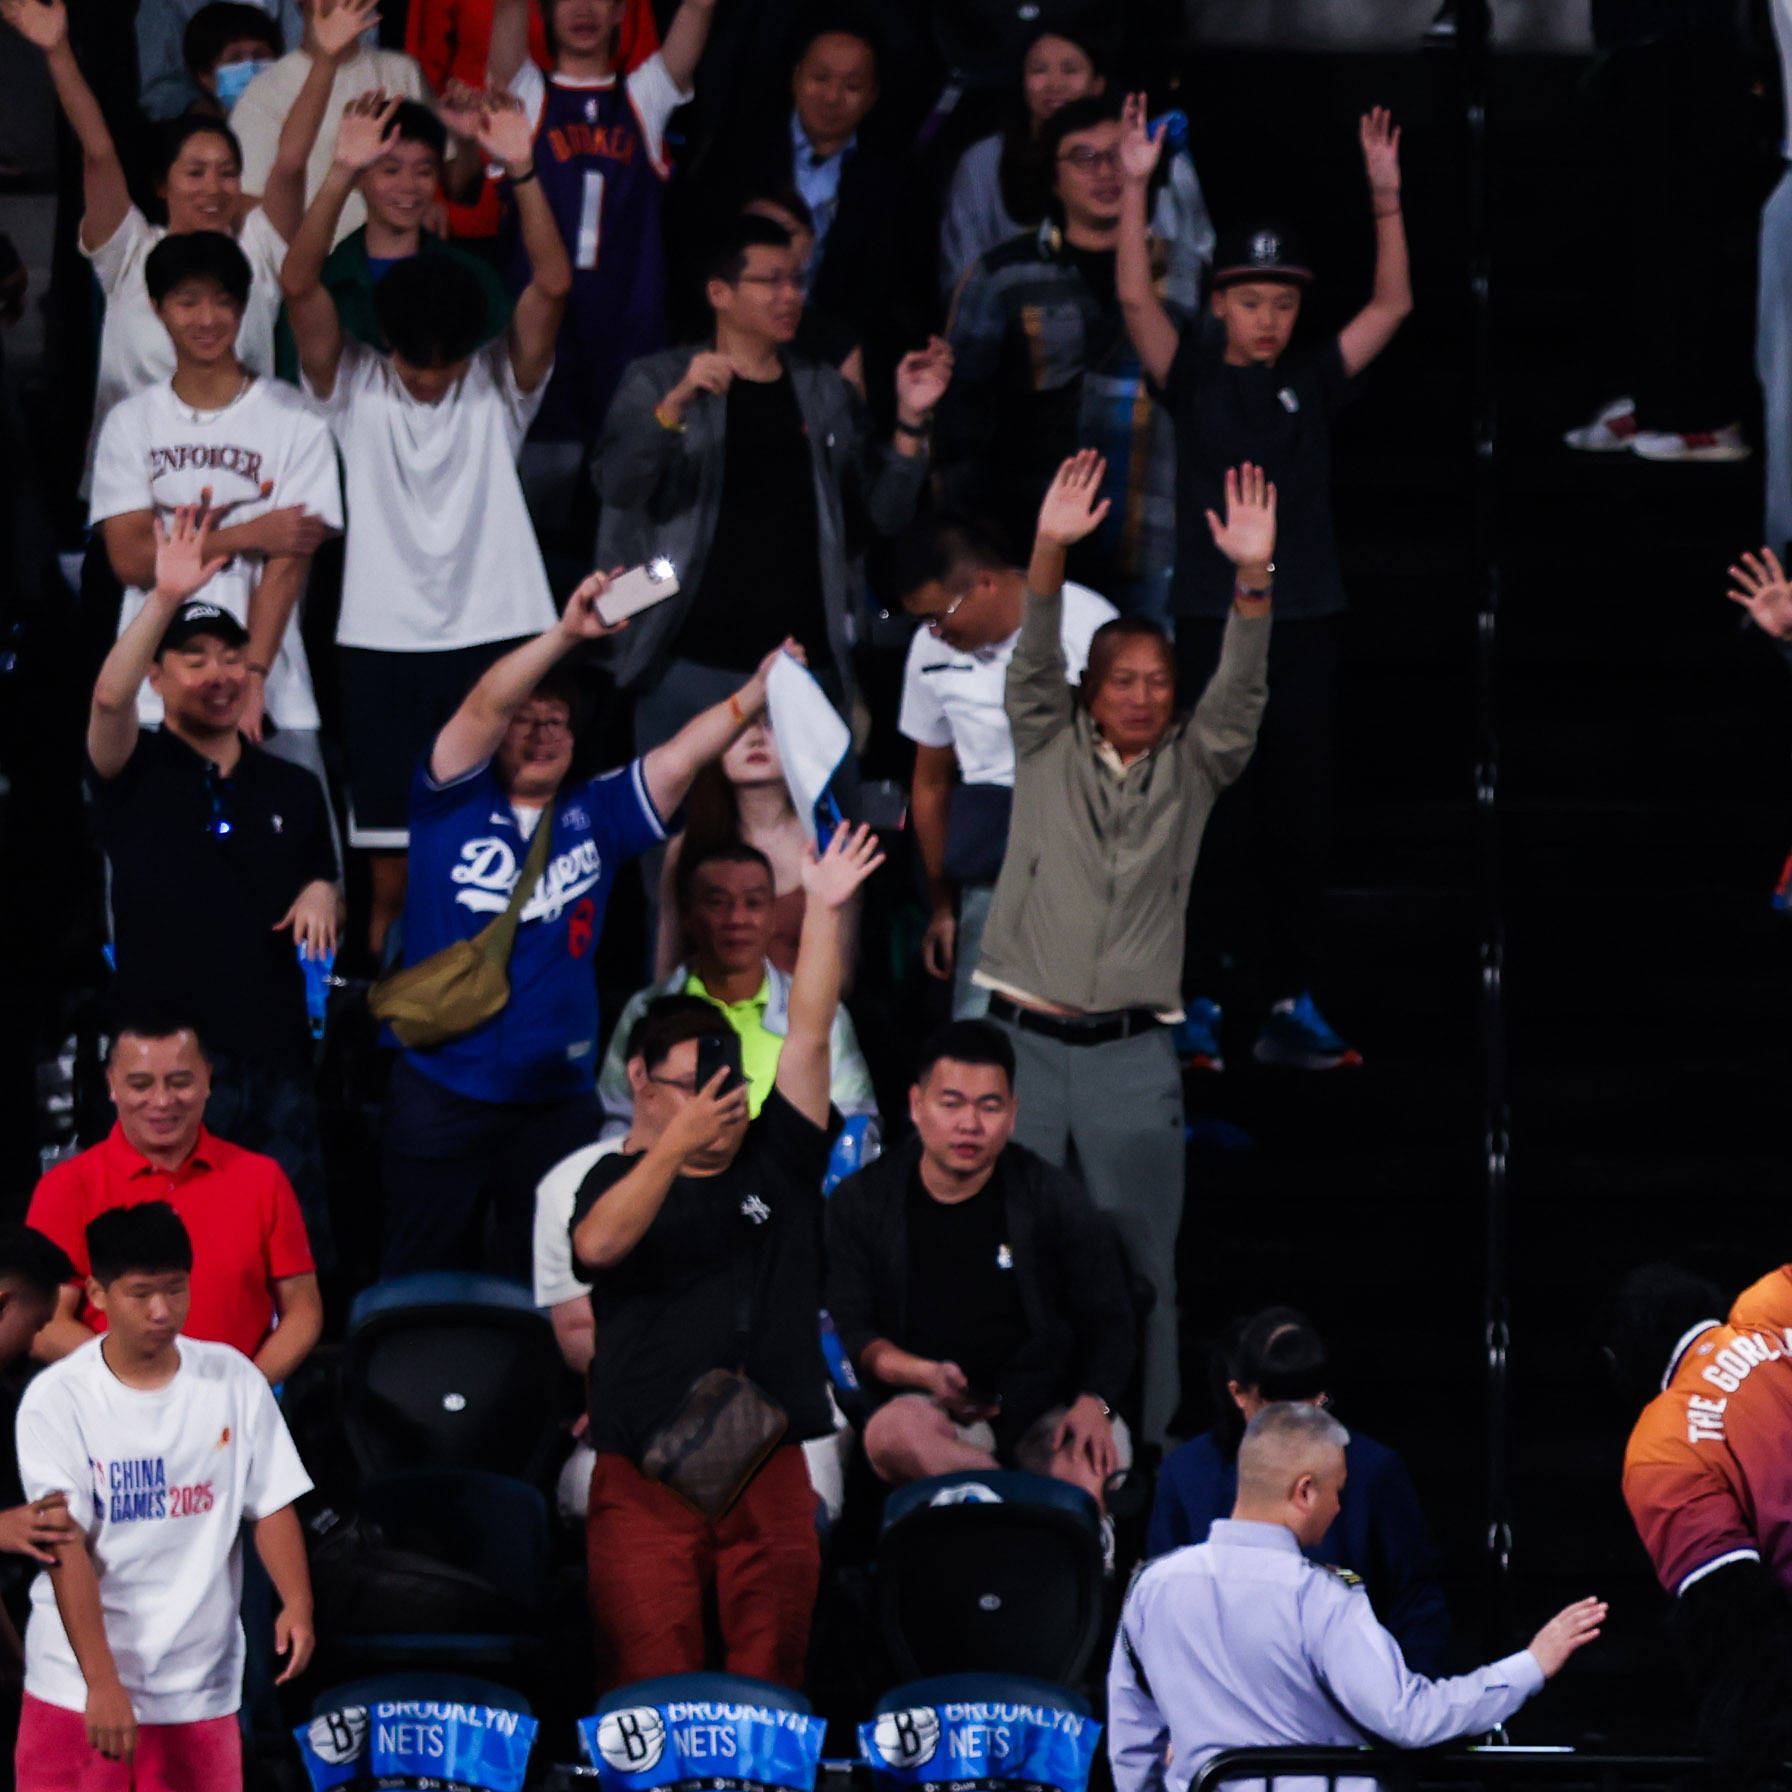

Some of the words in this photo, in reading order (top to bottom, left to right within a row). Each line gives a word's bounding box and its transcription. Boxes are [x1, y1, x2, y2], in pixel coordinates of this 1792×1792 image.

[579, 170, 606, 271] 1
[450, 836, 602, 922] Dgers
[1686, 1394, 1728, 1444] THE
[109, 1457, 165, 1493] CHINA
[110, 1488, 166, 1524] GAMES
[168, 1481, 214, 1518] 2025
[378, 1701, 519, 1736] BROOKLYN
[669, 1702, 809, 1734] BROOKLYN
[944, 1702, 1084, 1736] BROOKLYN
[378, 1725, 445, 1760] NETS
[674, 1726, 738, 1760] NETS
[948, 1726, 1010, 1759] NETS
